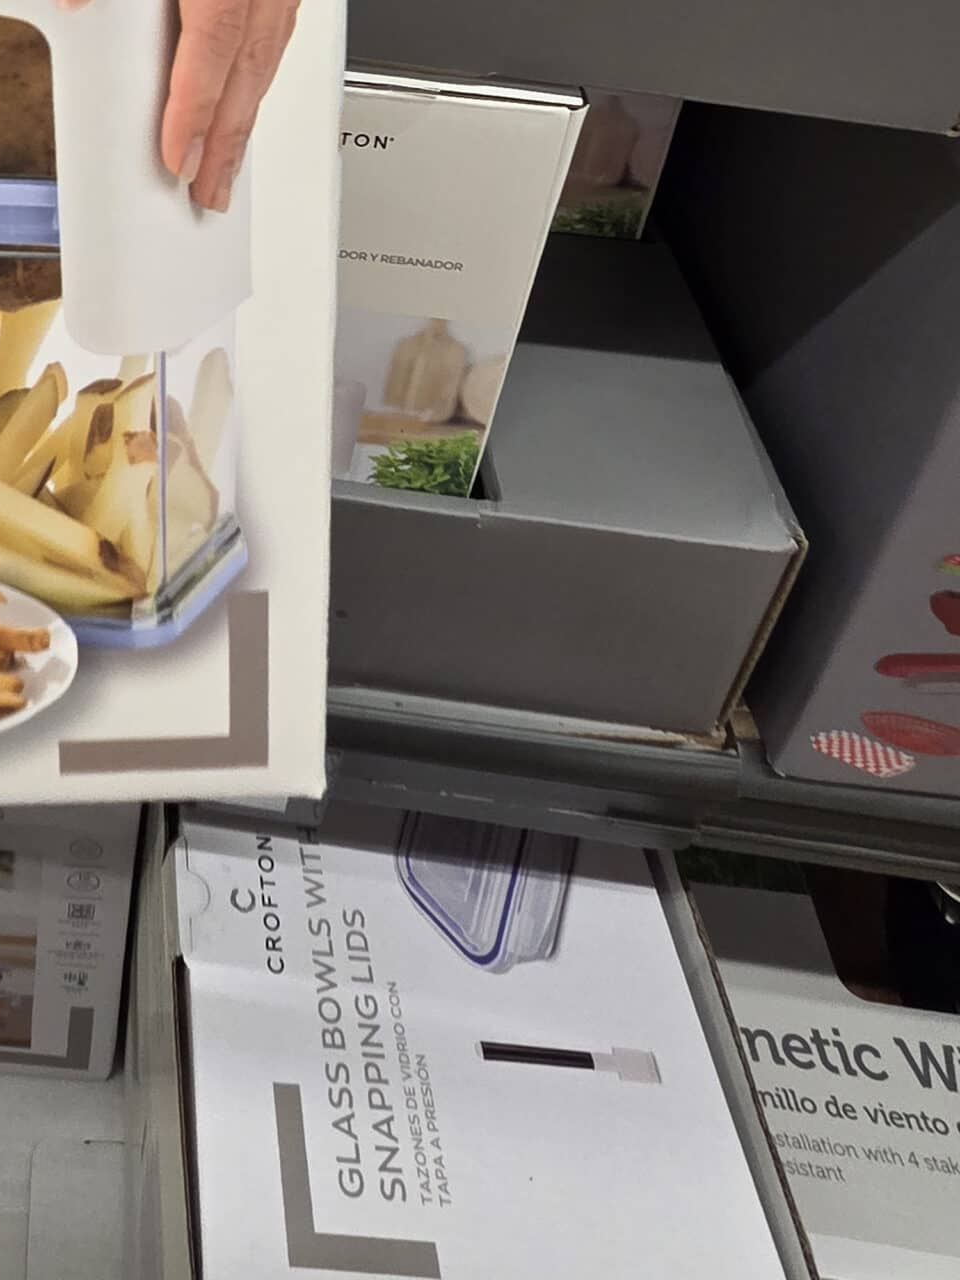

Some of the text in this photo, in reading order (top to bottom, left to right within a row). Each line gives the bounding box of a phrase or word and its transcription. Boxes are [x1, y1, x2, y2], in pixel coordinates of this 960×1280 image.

[381, 254, 463, 271] REBANADOR
[308, 917, 347, 1050] BOWLS
[343, 909, 407, 1202] SNAPPING LIDS
[388, 981, 431, 1206] TAZONES DE VIDRIO CON
[824, 1095, 858, 1120] de
[863, 1102, 950, 1135] viento
[892, 1036, 960, 1093] W
[325, 1060, 365, 1198] GLASS
[417, 1054, 452, 1207] TAPA A PRESIÓN
[861, 1145, 905, 1167] with
[908, 1151, 920, 1168] 4
